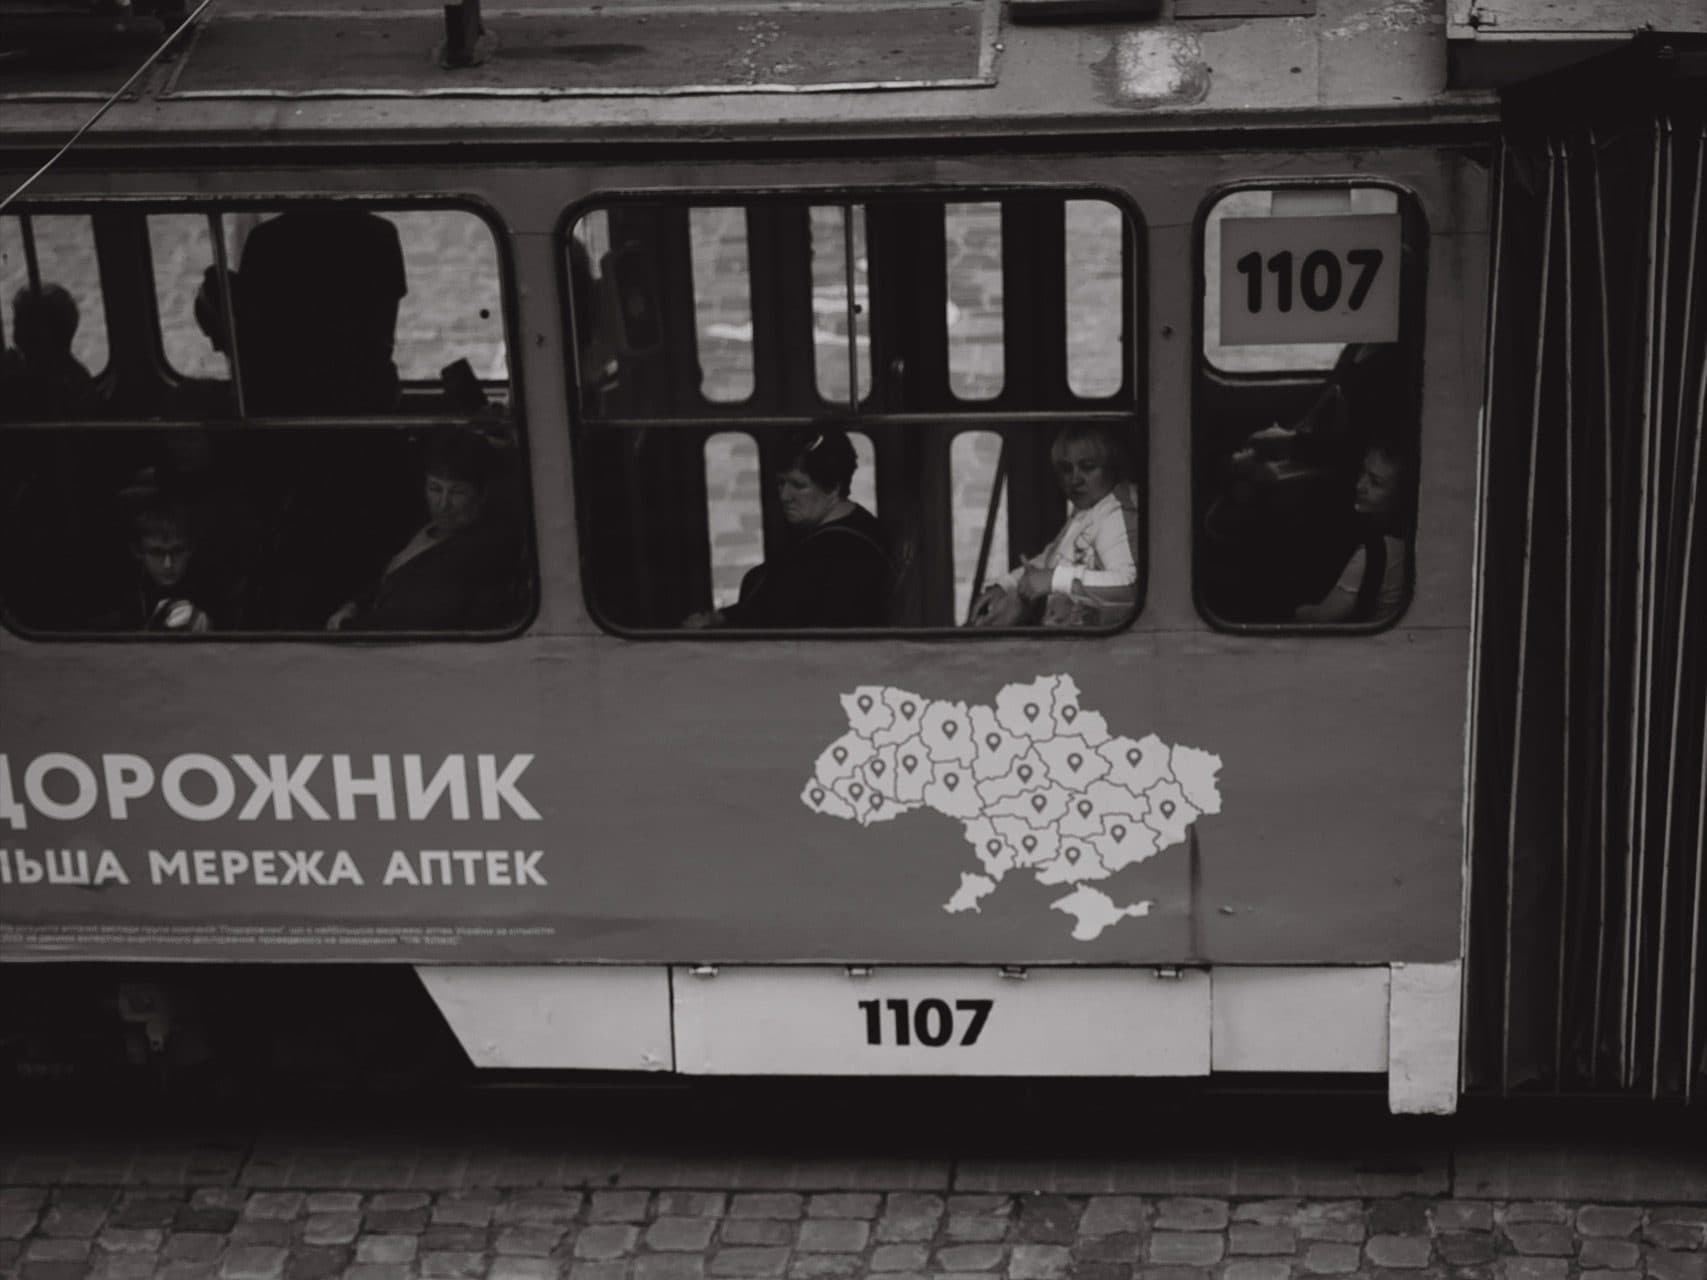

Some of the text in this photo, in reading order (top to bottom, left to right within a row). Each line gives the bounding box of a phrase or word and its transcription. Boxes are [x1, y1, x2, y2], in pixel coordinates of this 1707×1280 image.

[1236, 249, 1384, 314] 1107
[148, 849, 365, 886] МЕРЕЖА
[382, 849, 549, 886] АПТЕК
[858, 998, 995, 1048] 1107
